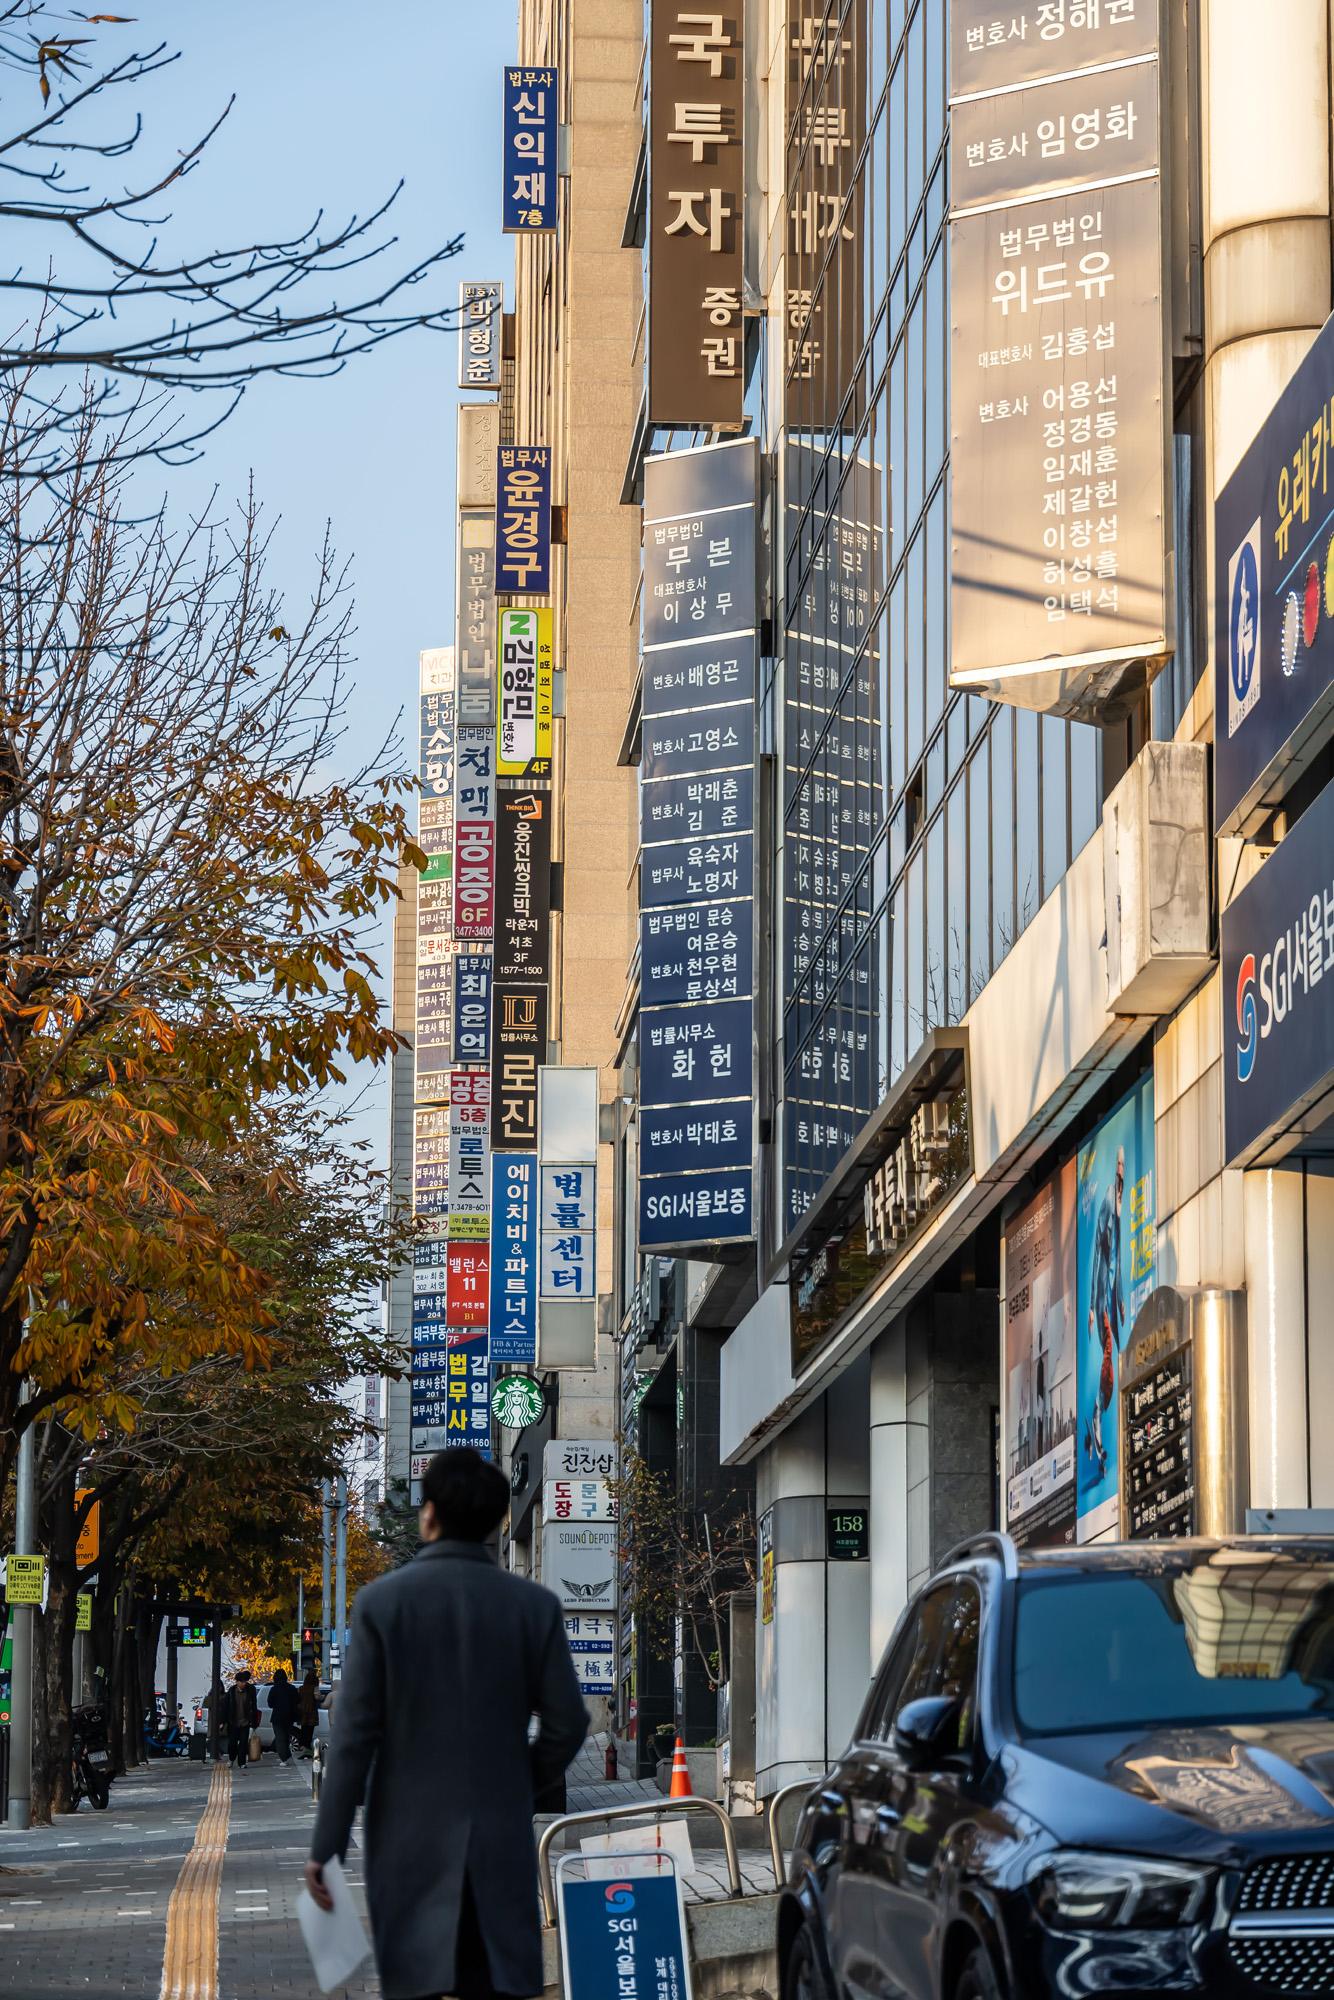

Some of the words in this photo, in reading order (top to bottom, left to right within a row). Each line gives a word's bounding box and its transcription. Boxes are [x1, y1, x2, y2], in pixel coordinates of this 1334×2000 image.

[966, 16, 1028, 52] 변호사
[508, 71, 554, 89] 법무사
[967, 131, 1029, 167] 변호사
[1036, 101, 1138, 159] 임영화
[512, 91, 547, 207] 신익재
[518, 209, 544, 227] 7층
[999, 212, 1103, 258] 법무법인
[465, 287, 498, 299] 변호사
[991, 251, 1115, 316] 위드유
[467, 300, 493, 382] 박형준
[700, 286, 740, 377] 증권
[978, 343, 1033, 368] 대표변호사
[1040, 322, 1116, 361] 김홍섭
[979, 396, 1029, 424] 변호사
[1042, 375, 1118, 412] 어용선
[1042, 410, 1118, 449] 정경동
[475, 413, 494, 491] 정신건강
[501, 450, 547, 468] 법무사
[1042, 445, 1118, 483] 임재훈
[1042, 479, 1118, 516] 제갈헌
[502, 470, 543, 587] 윤경구
[654, 520, 703, 545] 법무법인
[1042, 515, 1118, 550] 이창섭
[1042, 550, 1119, 586] 허성흠
[467, 551, 487, 643] 법무법인
[654, 575, 707, 599] 대표변호사
[1043, 585, 1118, 623] 임택석
[460, 649, 494, 714] 나눔
[503, 639, 534, 720] 김형민
[653, 669, 685, 690] 변호사
[688, 659, 740, 687] 배영곤
[427, 694, 453, 710] 법무
[427, 710, 453, 727] 법인
[458, 728, 493, 741] 법무법인
[502, 722, 514, 753] 변호사
[652, 737, 684, 756] 변호사
[687, 726, 739, 753] 고영소
[531, 762, 548, 773] 4F
[687, 778, 739, 803] 박래춘
[652, 803, 684, 821] 변호사
[421, 832, 439, 844] 법무사
[457, 826, 492, 904] 공증
[687, 842, 739, 868] 육숙자
[513, 822, 532, 917] 웅진씽크빅
[651, 865, 684, 885] 법무사
[420, 884, 438, 899] 법무사
[686, 870, 739, 894] 노명자
[420, 914, 438, 925] 법무사
[461, 908, 489, 922] 6F
[506, 919, 538, 931] 라운지
[649, 911, 700, 935] 법무법인
[707, 907, 734, 927] 문승
[456, 926, 493, 937] 3477-3400
[509, 937, 532, 948] 서초
[687, 930, 738, 953] 여운승
[459, 958, 490, 971] 법무사
[514, 953, 529, 963] 3F
[651, 963, 683, 979] 변호사
[686, 954, 737, 978] 천우현
[419, 968, 437, 980] 법무사
[500, 966, 542, 975] 1577-1500
[686, 976, 737, 1001] 문상석
[418, 995, 437, 1008] 법무사
[418, 1022, 437, 1034] 변호사
[460, 974, 487, 1058] 최윤억
[501, 1033, 538, 1042] 법률사무소
[651, 1022, 716, 1047] 법률사무소
[417, 1078, 435, 1089] 변호사
[451, 1076, 490, 1103] 공증
[501, 1054, 536, 1138] 로진
[417, 1114, 435, 1125] 변호사
[460, 1108, 486, 1122] 5층
[451, 1126, 490, 1135] 법무법인
[650, 1128, 683, 1146] 변호사
[686, 1119, 738, 1146] 박태호
[417, 1141, 435, 1152] 변호사
[416, 1166, 435, 1179] 법무사
[458, 1138, 484, 1198] 로투스
[415, 1193, 434, 1205] 변호사
[647, 1187, 746, 1220] SGI서울보증
[449, 1257, 489, 1274] 밸런스
[463, 1277, 476, 1291] 11
[414, 1298, 433, 1311] 법무사
[448, 1336, 459, 1344] 7F
[413, 1378, 432, 1390] 변호사
[448, 1354, 468, 1431] 법무사
[471, 1356, 488, 1429] 김일동
[413, 1405, 432, 1417] 법무사
[447, 1438, 490, 1447] 3478-1560
[412, 1458, 432, 1475] 삼풍
[561, 1453, 614, 1474] 진진샵
[555, 1482, 572, 1518] 도장
[581, 1484, 597, 1517] 문구
[833, 1516, 863, 1532] 158
[559, 1533, 586, 1544] SOUND
[608, 1918, 638, 1933] SGI
[614, 1936, 638, 2000] 서울보
